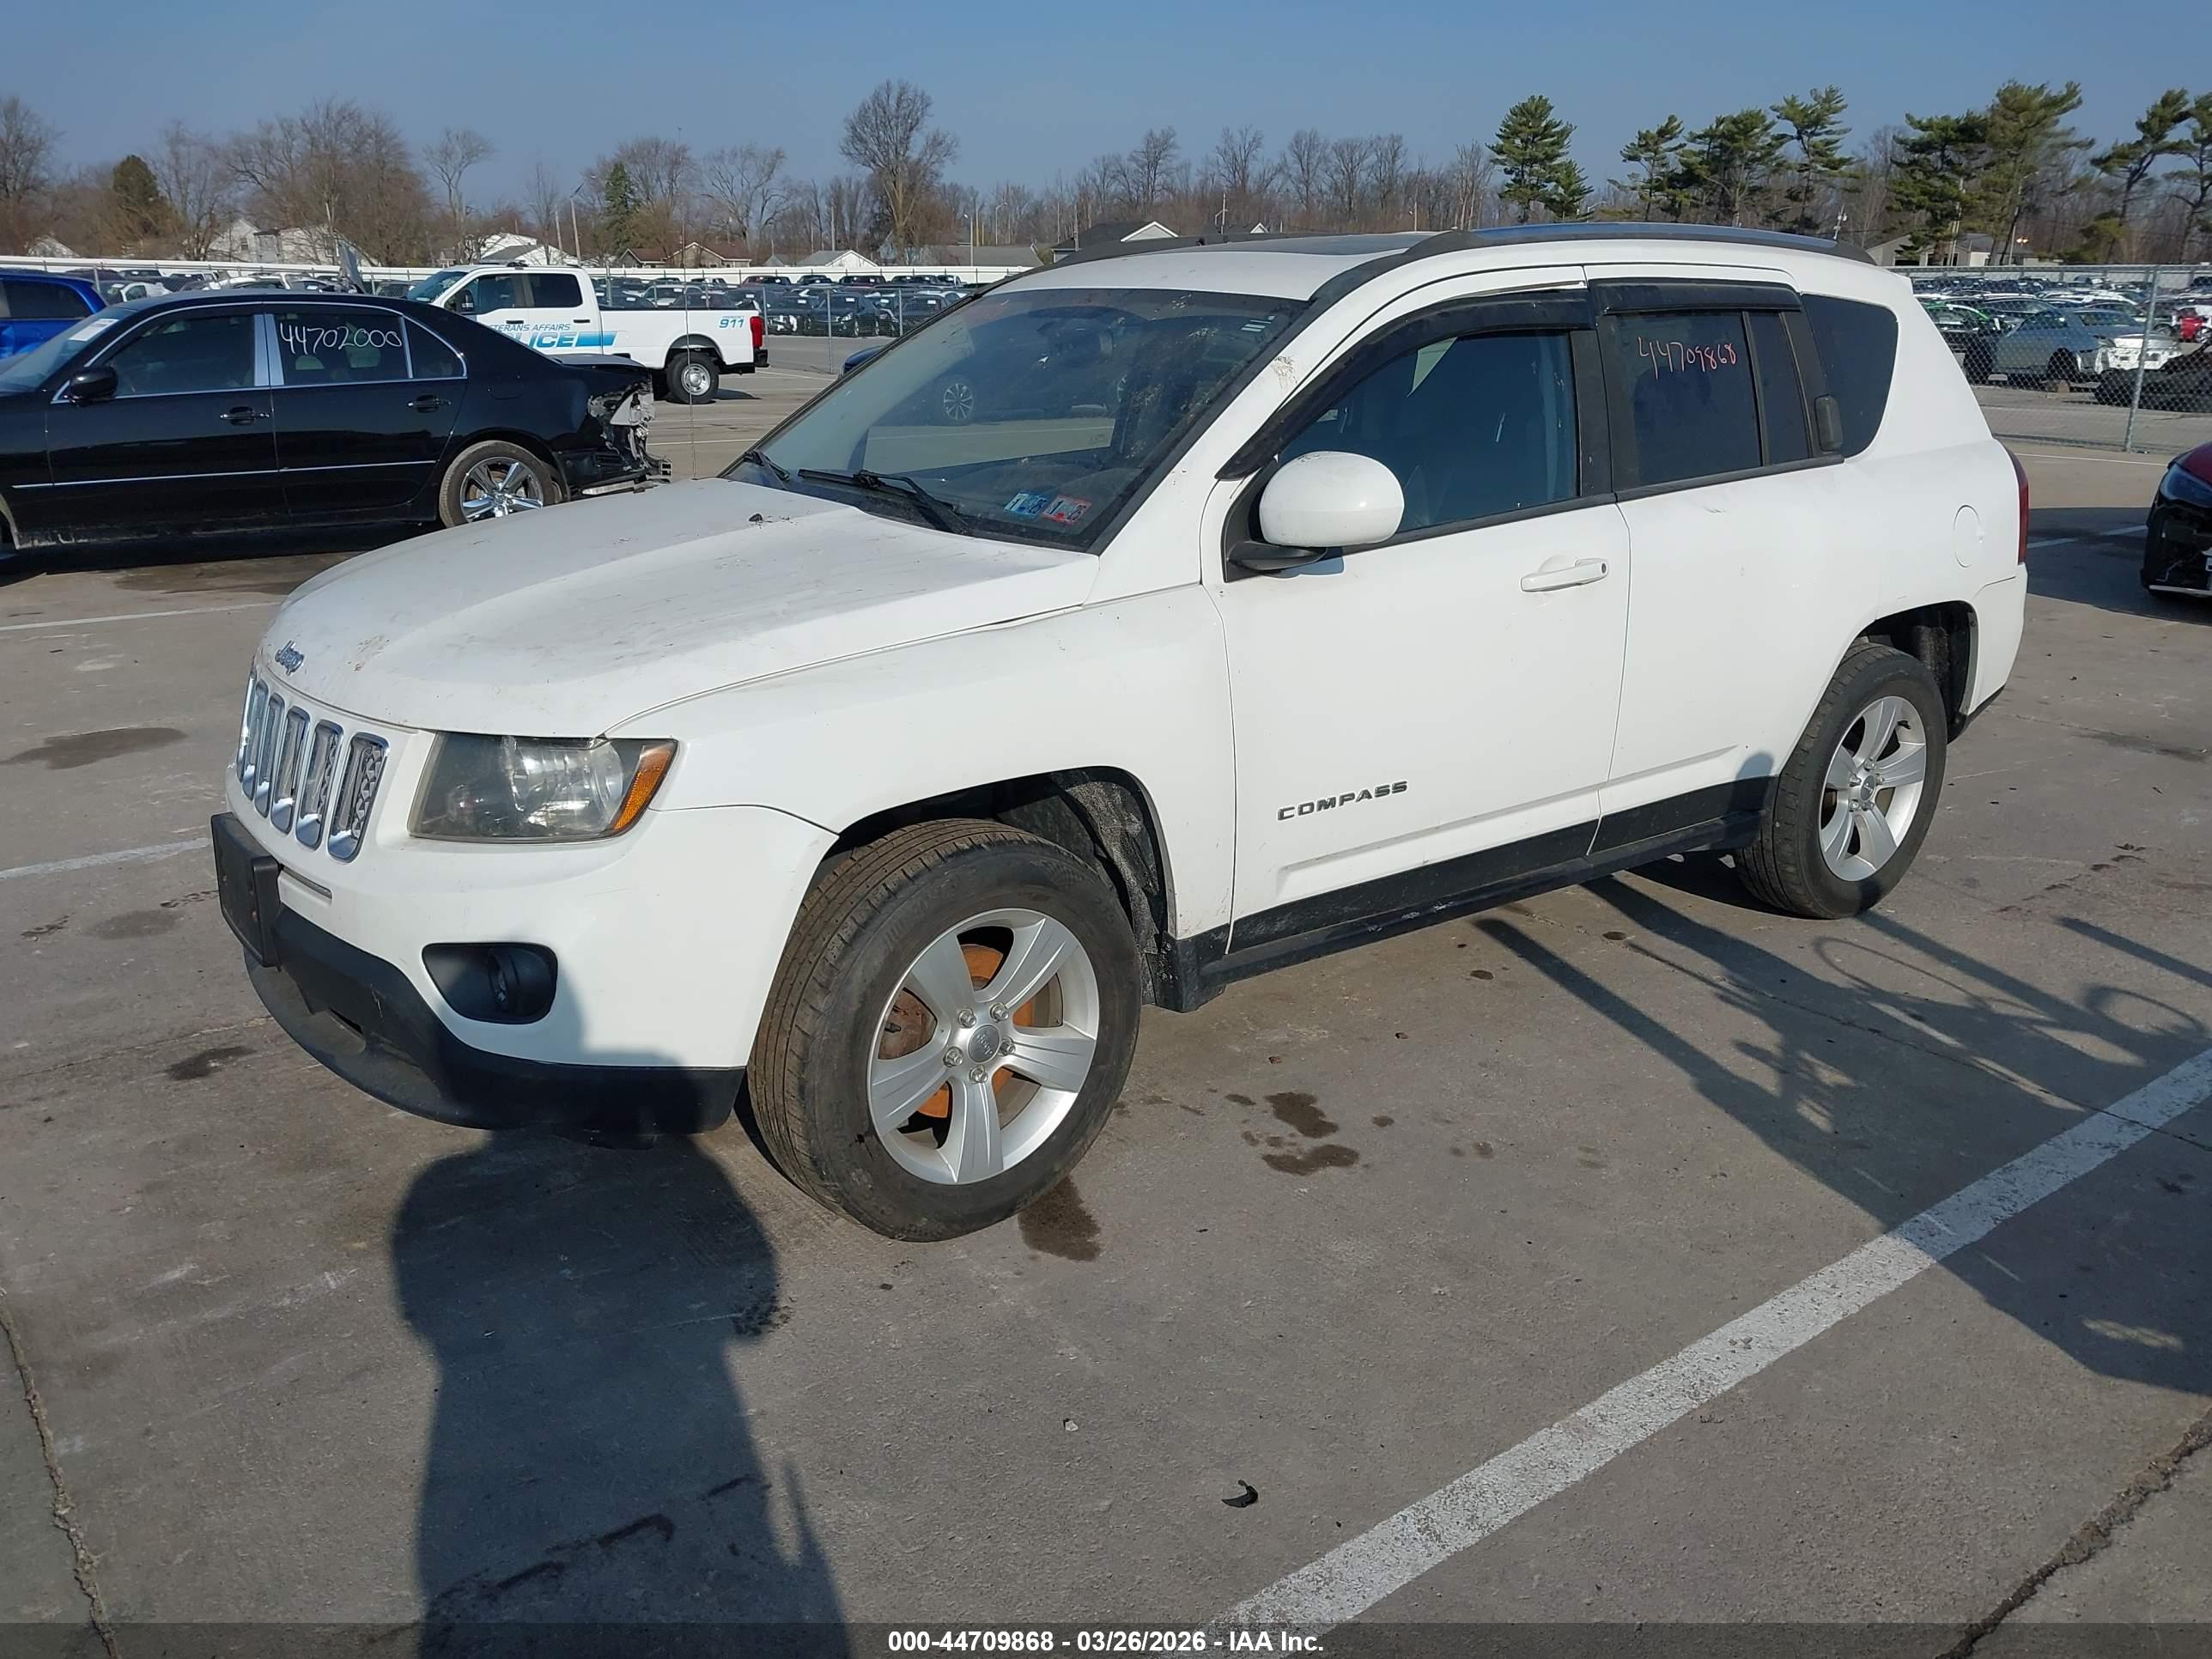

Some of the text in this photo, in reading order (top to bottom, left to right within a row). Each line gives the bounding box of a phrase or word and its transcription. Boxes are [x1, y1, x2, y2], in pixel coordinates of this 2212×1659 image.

[280, 322, 402, 355] 44702000
[719, 319, 744, 328] 911
[1638, 337, 1736, 380] 44709868
[1277, 781, 1408, 821] COMPASS
